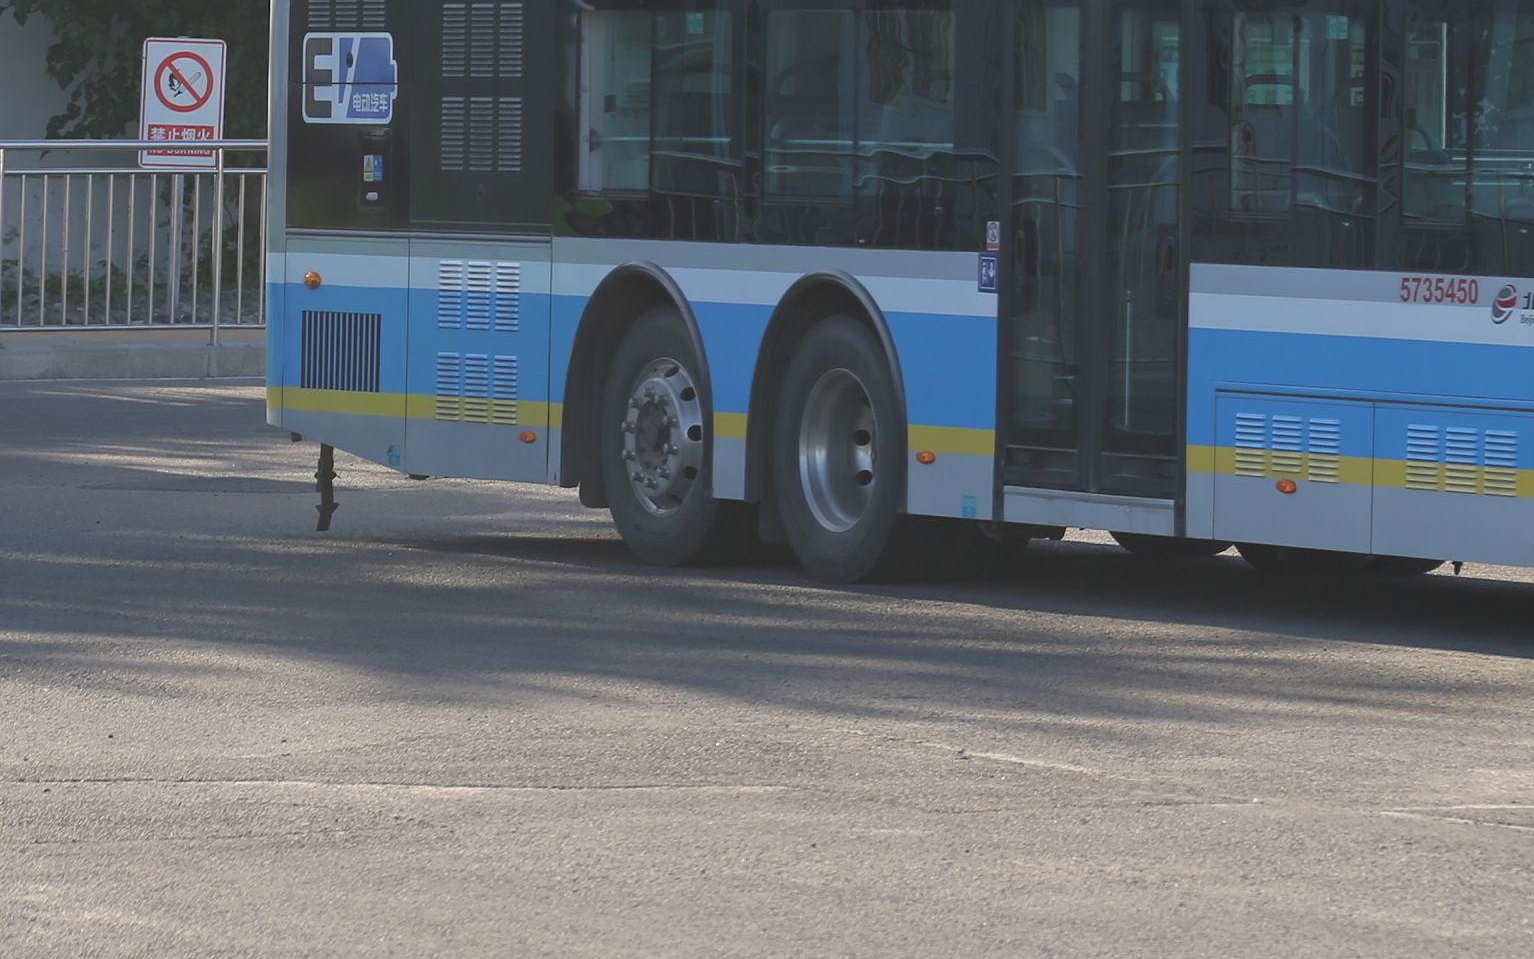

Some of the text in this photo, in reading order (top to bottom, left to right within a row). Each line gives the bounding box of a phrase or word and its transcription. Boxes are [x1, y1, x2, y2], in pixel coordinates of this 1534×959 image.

[353, 93, 389, 113] 电动汽车
[1400, 277, 1478, 305] 5735450
